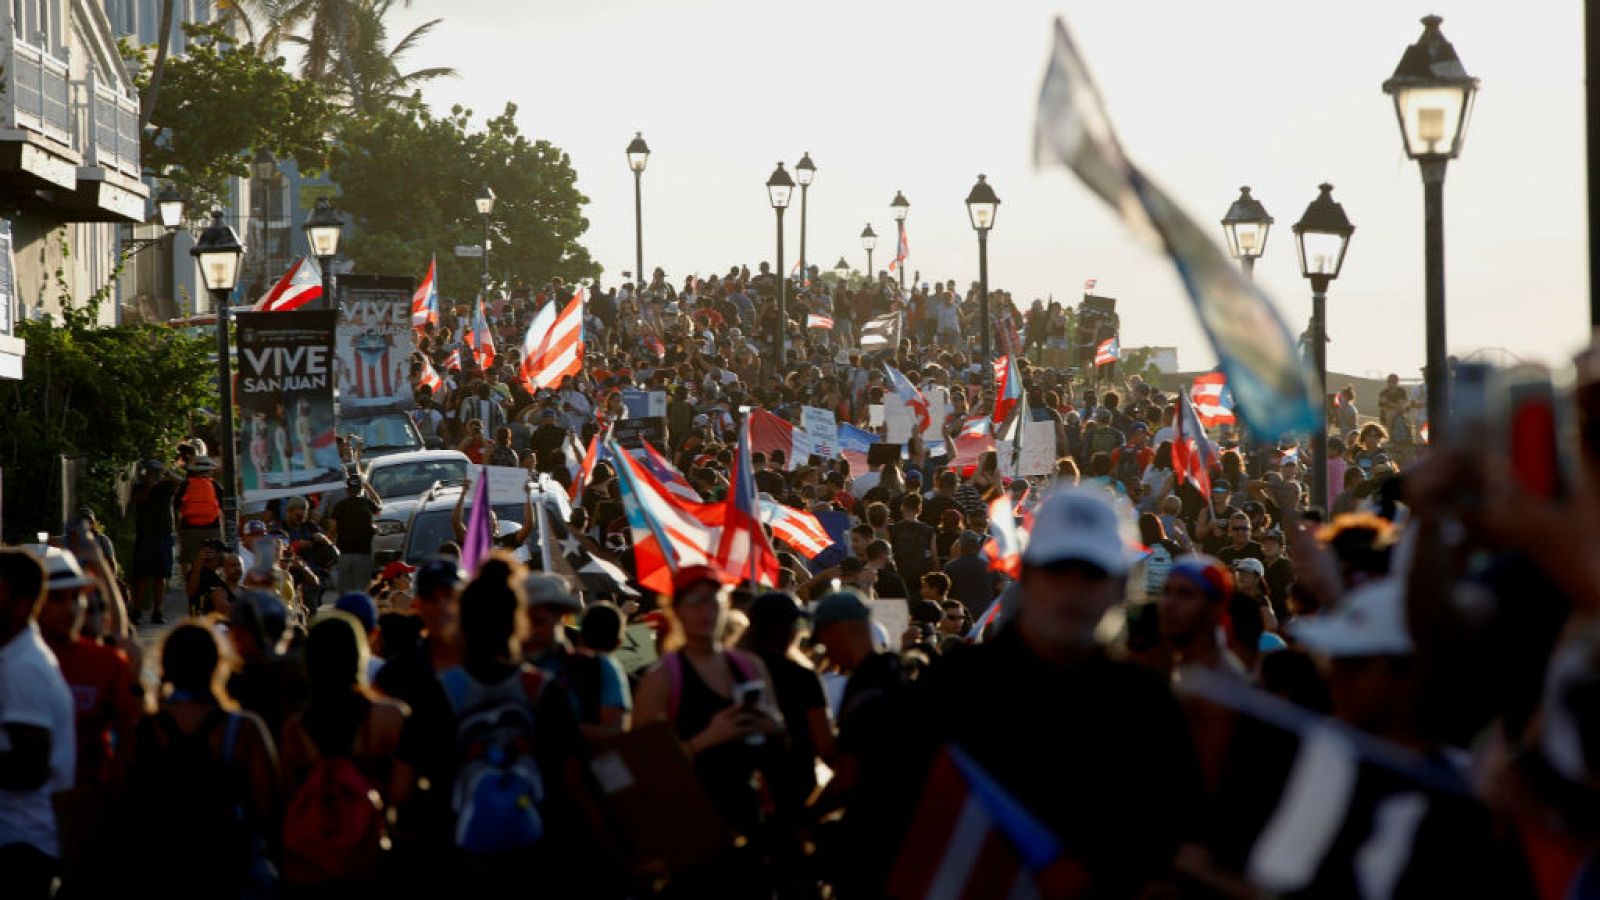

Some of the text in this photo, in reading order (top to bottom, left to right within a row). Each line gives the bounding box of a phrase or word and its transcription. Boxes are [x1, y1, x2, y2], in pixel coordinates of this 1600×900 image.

[340, 301, 409, 324] VIVE
[243, 346, 328, 376] VIVE
[243, 375, 326, 392] SAN JUAN
